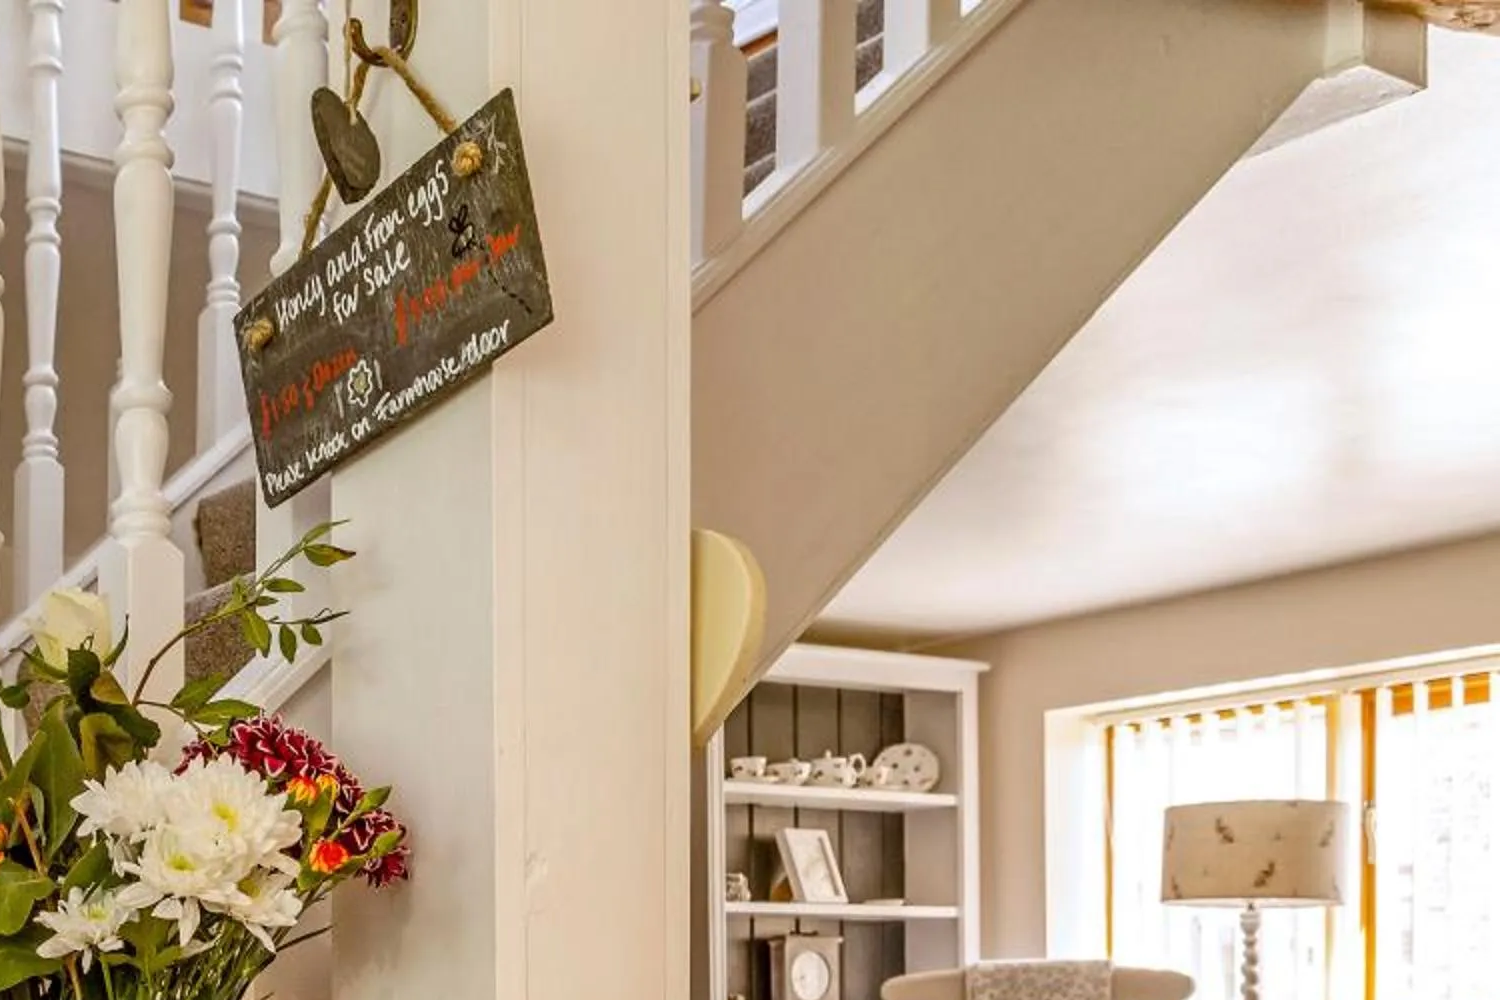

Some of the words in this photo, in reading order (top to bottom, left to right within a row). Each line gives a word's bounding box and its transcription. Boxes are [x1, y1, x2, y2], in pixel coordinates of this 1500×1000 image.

[275, 273, 325, 333] Honey
[326, 235, 367, 287] and
[407, 159, 449, 227] eggs
[351, 416, 371, 441] on
[466, 318, 510, 366] door
